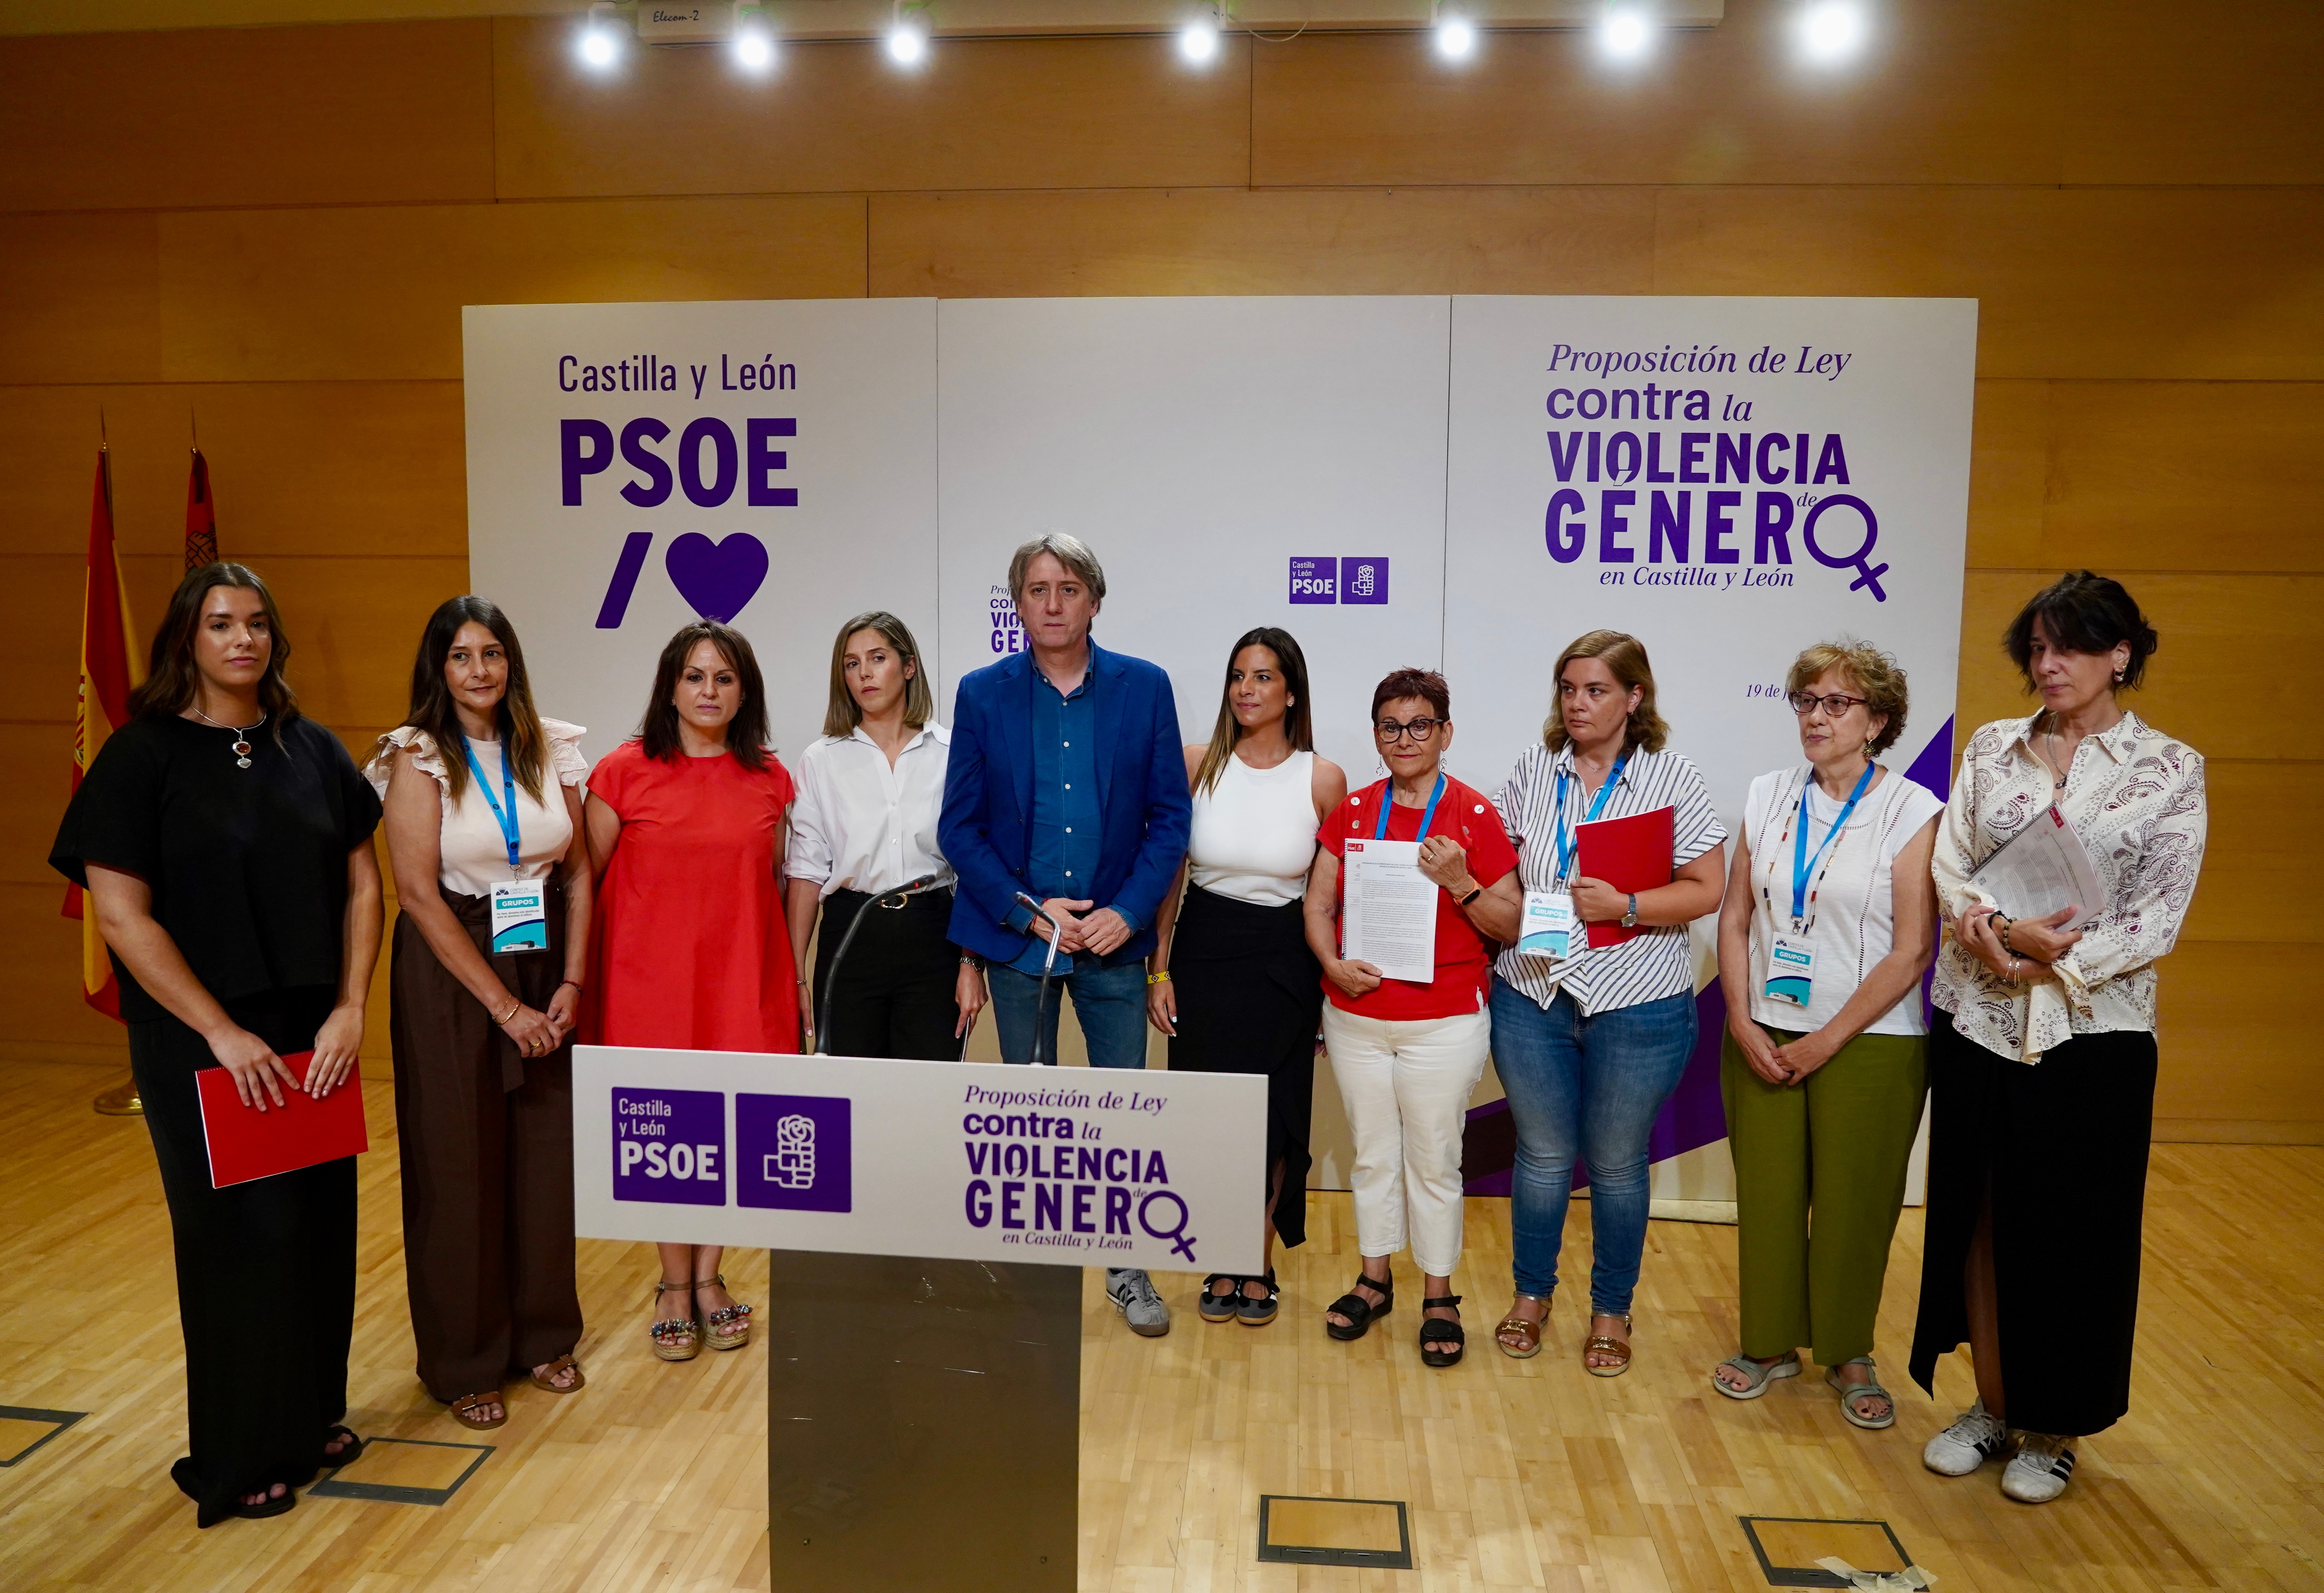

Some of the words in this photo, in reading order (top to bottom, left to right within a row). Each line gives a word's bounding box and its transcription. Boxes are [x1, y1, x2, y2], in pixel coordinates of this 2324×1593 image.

[1547, 344, 1736, 379] Proposición
[1749, 346, 1786, 373] de
[1794, 346, 1852, 381] Ley
[559, 355, 677, 392] Castilla
[690, 365, 707, 400] y
[722, 353, 796, 391] León
[1546, 383, 1710, 421] contra
[1723, 394, 1753, 421] la
[560, 417, 798, 508] PSOE
[1546, 431, 1850, 485] VIOLENCIA
[1797, 493, 1816, 508] de
[1292, 578, 1334, 594] PSOE
[1600, 572, 1625, 585] en
[1634, 567, 1717, 586] Castilla
[1722, 572, 1737, 591] y
[1741, 568, 1794, 587] León
[1746, 684, 1762, 697] 19
[1765, 684, 1780, 697] de
[1535, 908, 1563, 916] GRUPOS
[1779, 951, 1806, 962] GRUPOS
[618, 1098, 672, 1117] Castilla
[964, 1085, 1090, 1109] Proposición
[1098, 1091, 1123, 1110] de
[1129, 1091, 1168, 1116] Ley
[619, 1122, 627, 1138] y
[632, 1118, 665, 1136] León
[963, 1112, 1074, 1139] contra
[1081, 1122, 1102, 1141] la
[620, 1140, 719, 1181] PSOE
[964, 1141, 1169, 1184] VIOLENCIA
[1002, 1233, 1019, 1244] en
[1025, 1231, 1081, 1248] Castilla
[1084, 1237, 1095, 1251] y
[1098, 1235, 1133, 1250] León
